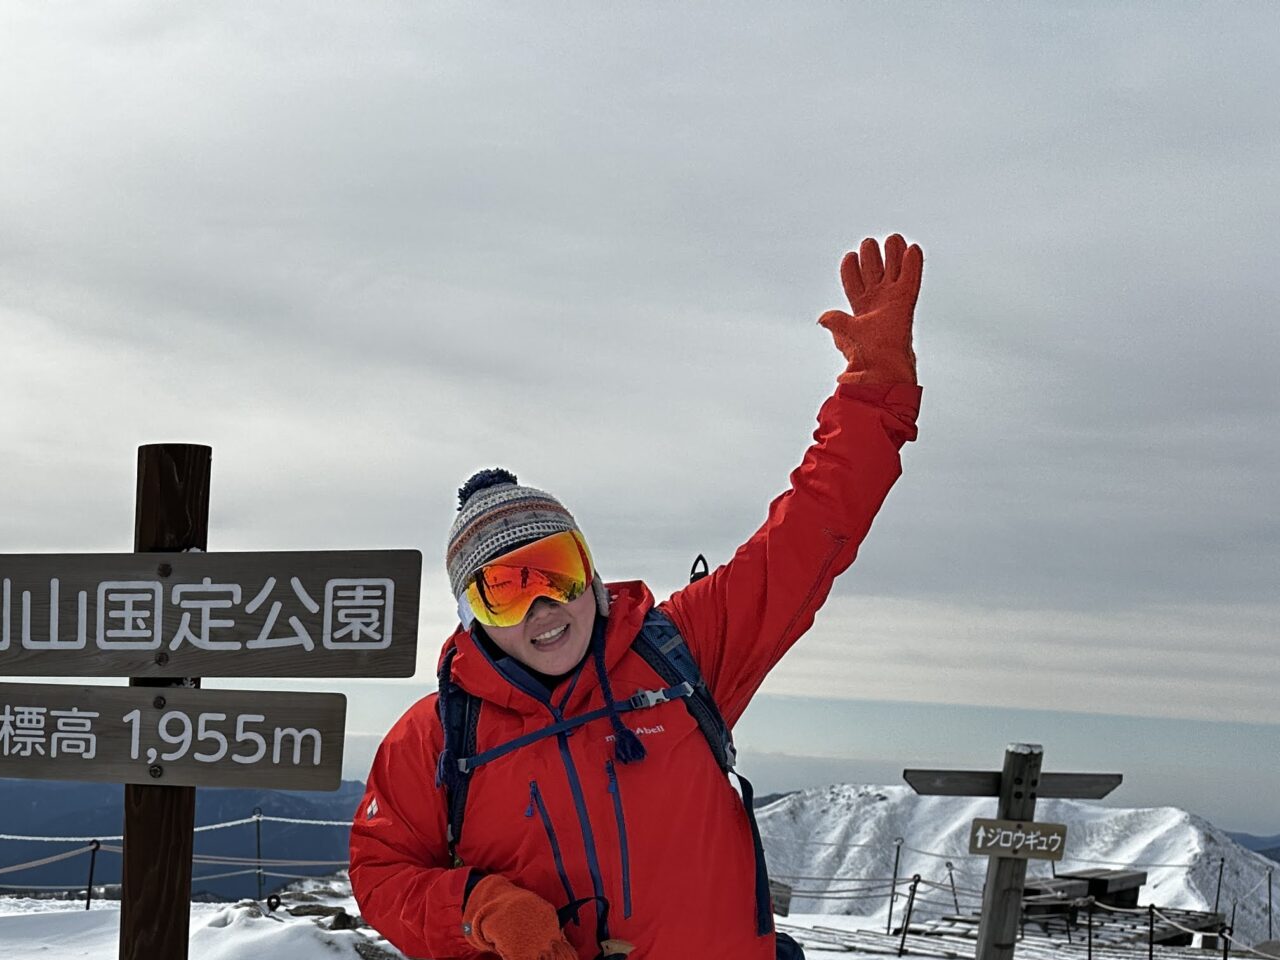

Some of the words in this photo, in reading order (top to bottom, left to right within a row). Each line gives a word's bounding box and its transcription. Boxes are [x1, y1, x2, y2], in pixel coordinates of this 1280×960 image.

[122, 709, 322, 765] 1,955m
[986, 828, 1062, 853] ジロウギュウ
